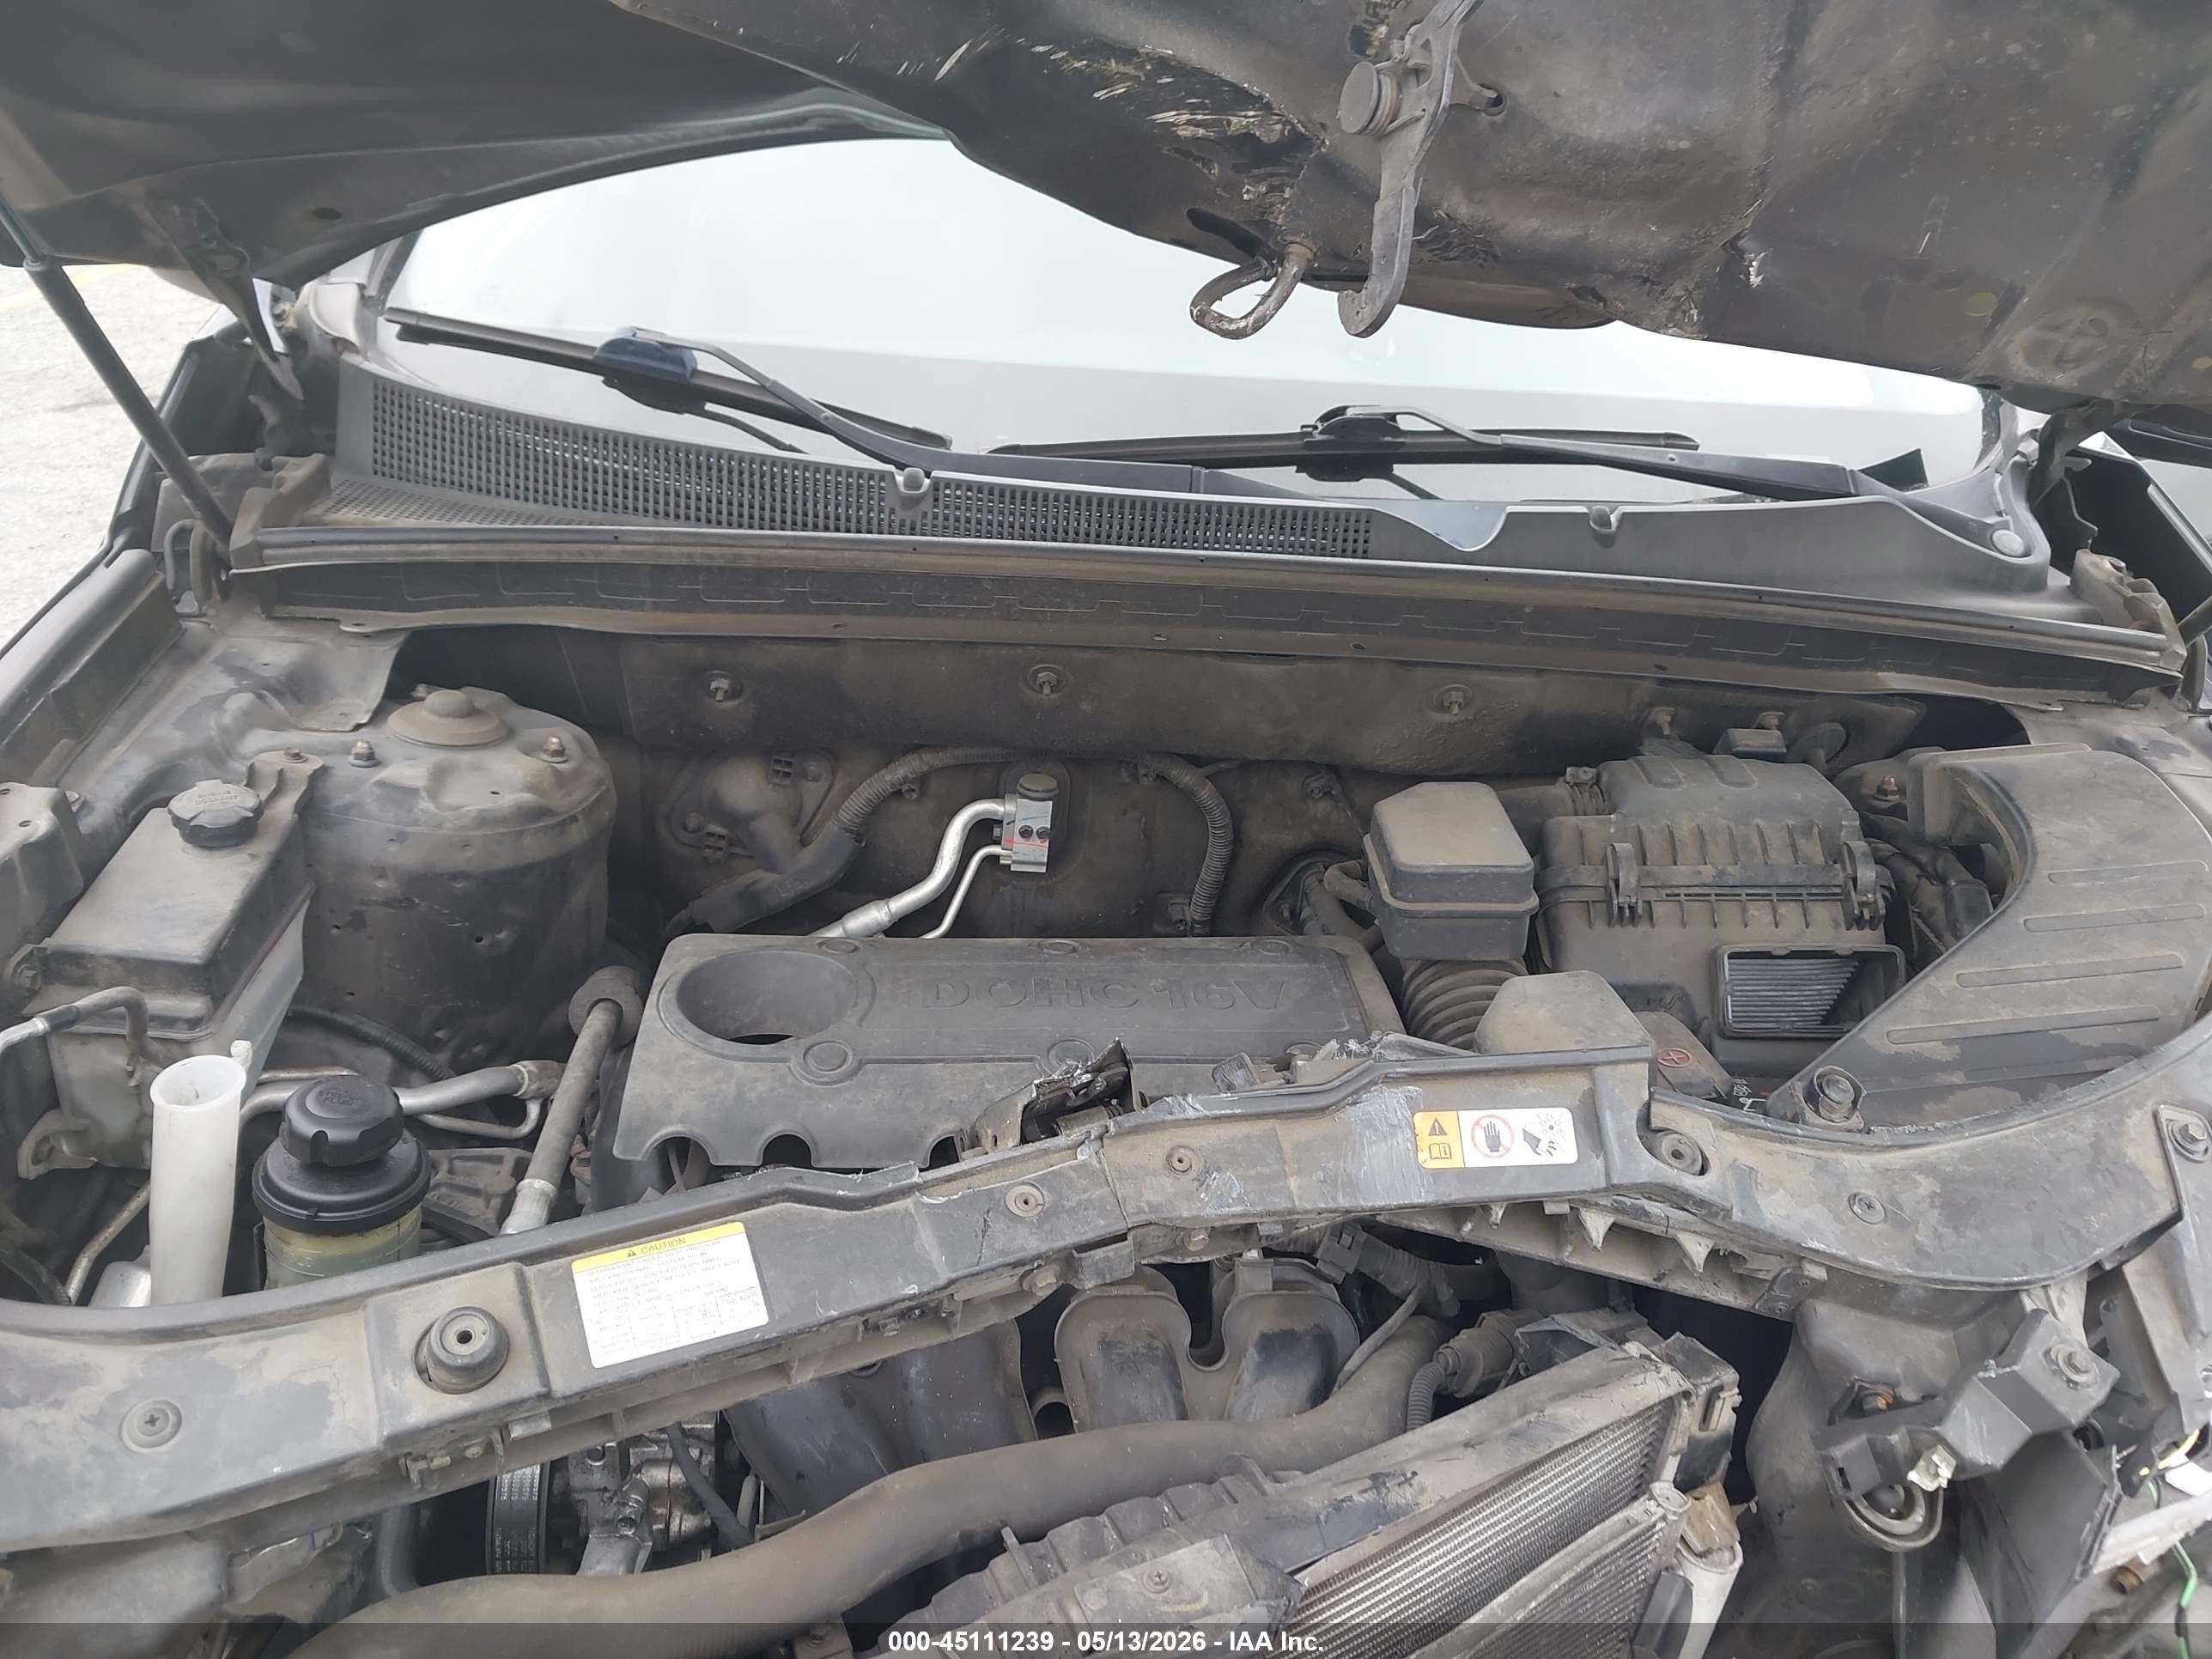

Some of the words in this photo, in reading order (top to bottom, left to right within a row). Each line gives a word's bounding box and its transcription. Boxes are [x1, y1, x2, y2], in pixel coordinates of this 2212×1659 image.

[921, 976, 1140, 1009] DOHC
[1151, 979, 1286, 1011] 16V
[641, 1237, 686, 1254] CAUTION
